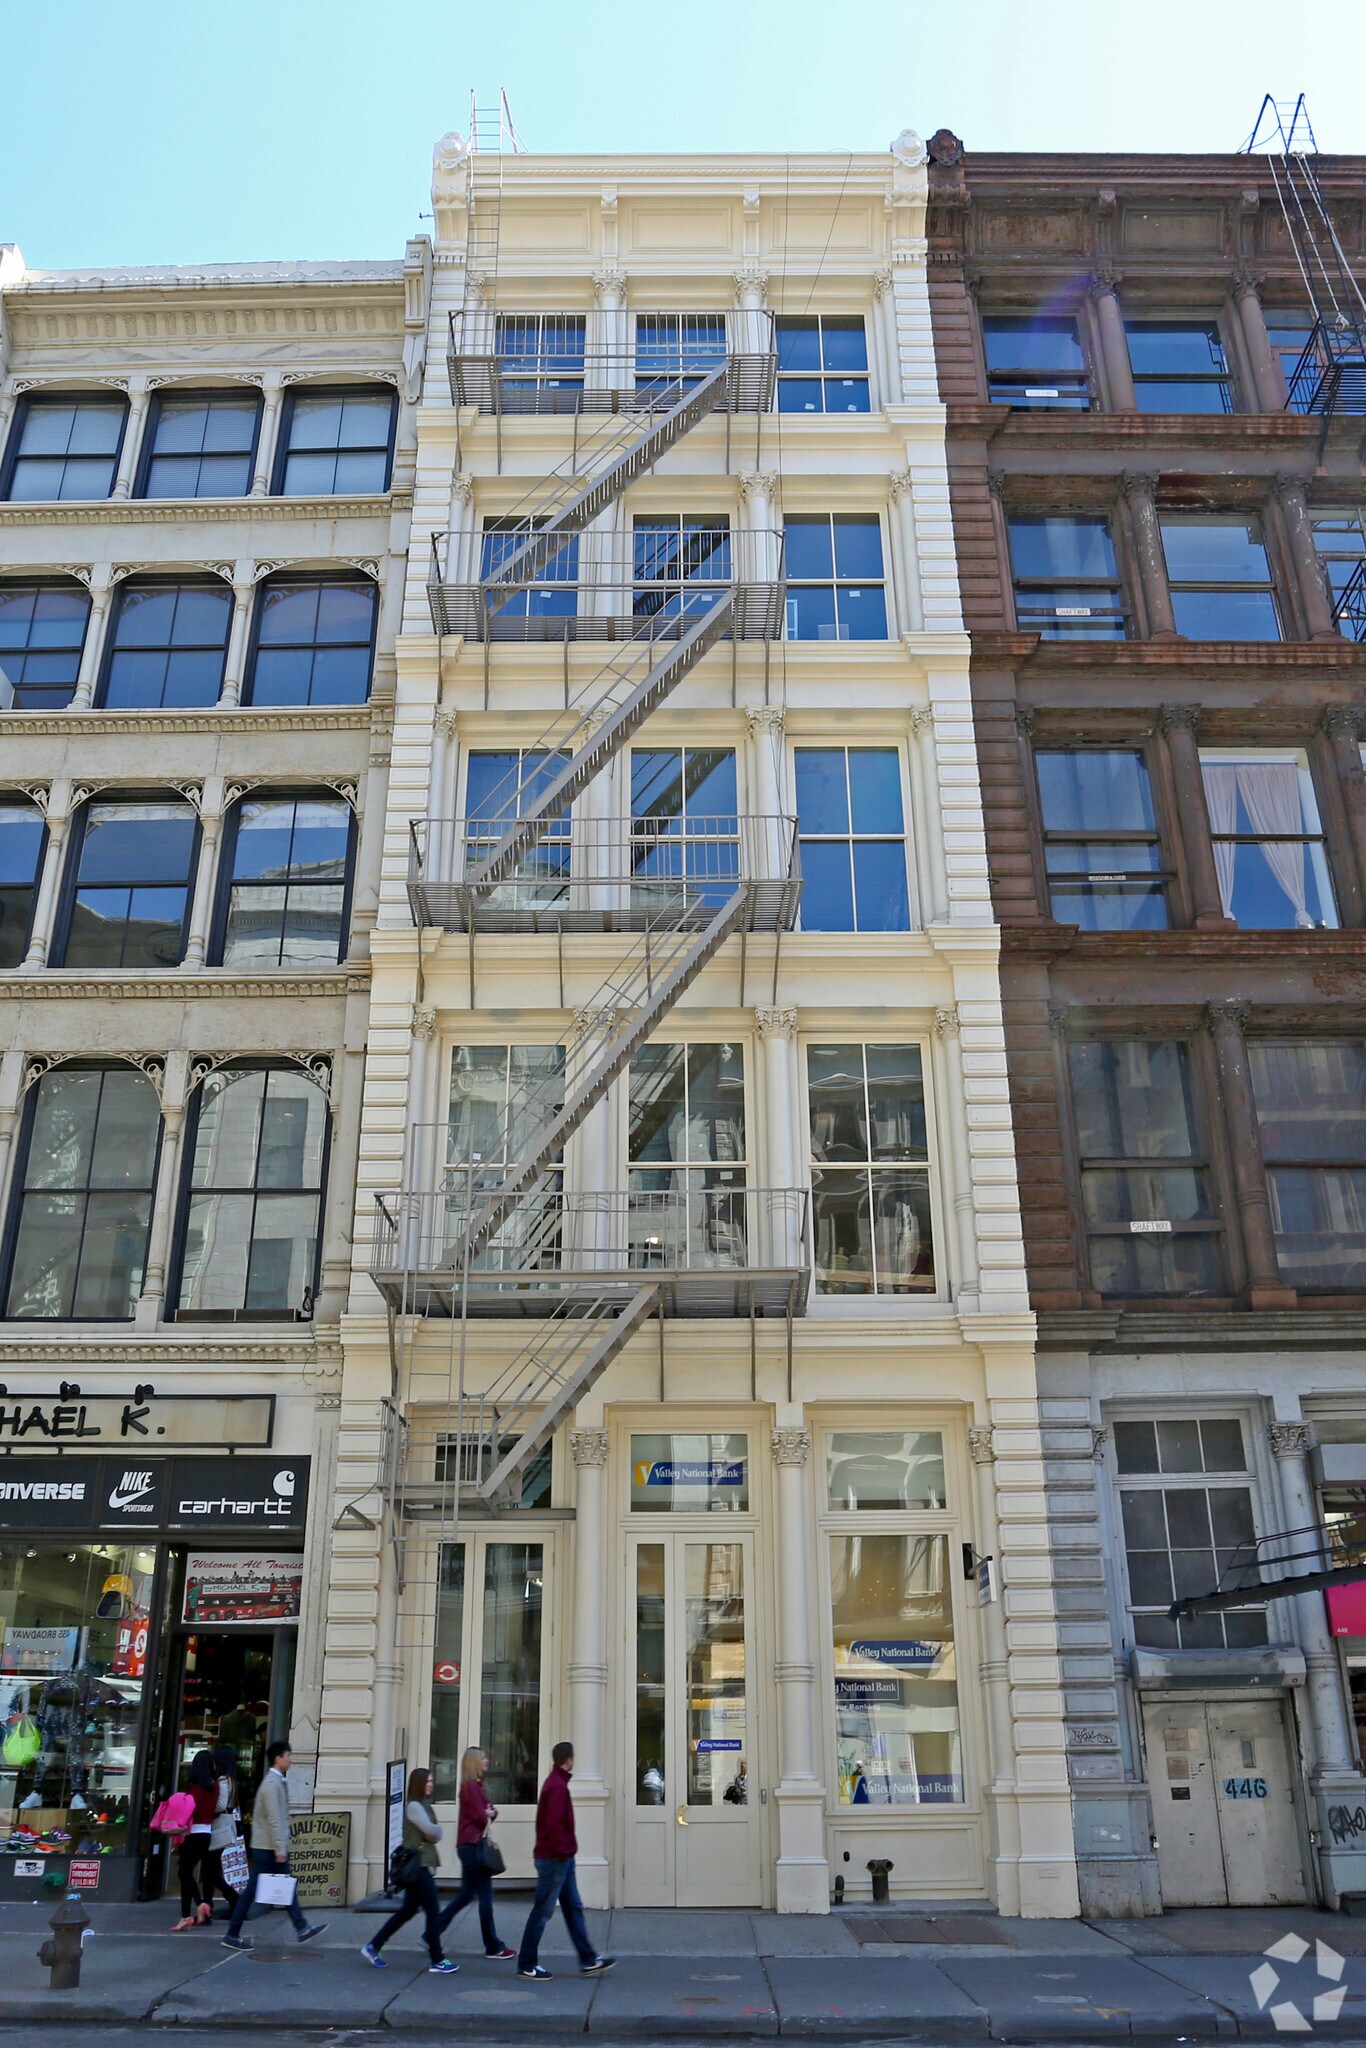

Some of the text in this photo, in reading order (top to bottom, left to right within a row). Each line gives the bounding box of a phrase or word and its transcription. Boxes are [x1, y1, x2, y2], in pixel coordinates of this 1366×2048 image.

[1132, 1222, 1169, 1232] SHAFTWAY
[121, 1405, 165, 1437] K.
[655, 1466, 739, 1480] Valley National Bank
[119, 1471, 153, 1491] NIKE
[122, 1504, 154, 1512] SPORTSWEAR
[178, 1497, 292, 1515] carhartt
[192, 1559, 304, 1570] Welcome All Tourist
[212, 1583, 248, 1591] MICHAEL
[855, 1645, 937, 1660] Valley National Bank
[840, 1682, 874, 1692] National
[876, 1682, 897, 1692] Bank
[862, 1780, 960, 1797] Valley National Bank
[1225, 1777, 1268, 1799] 446
[288, 1849, 343, 1861] EDSPREADS
[327, 1887, 341, 1898] 450
